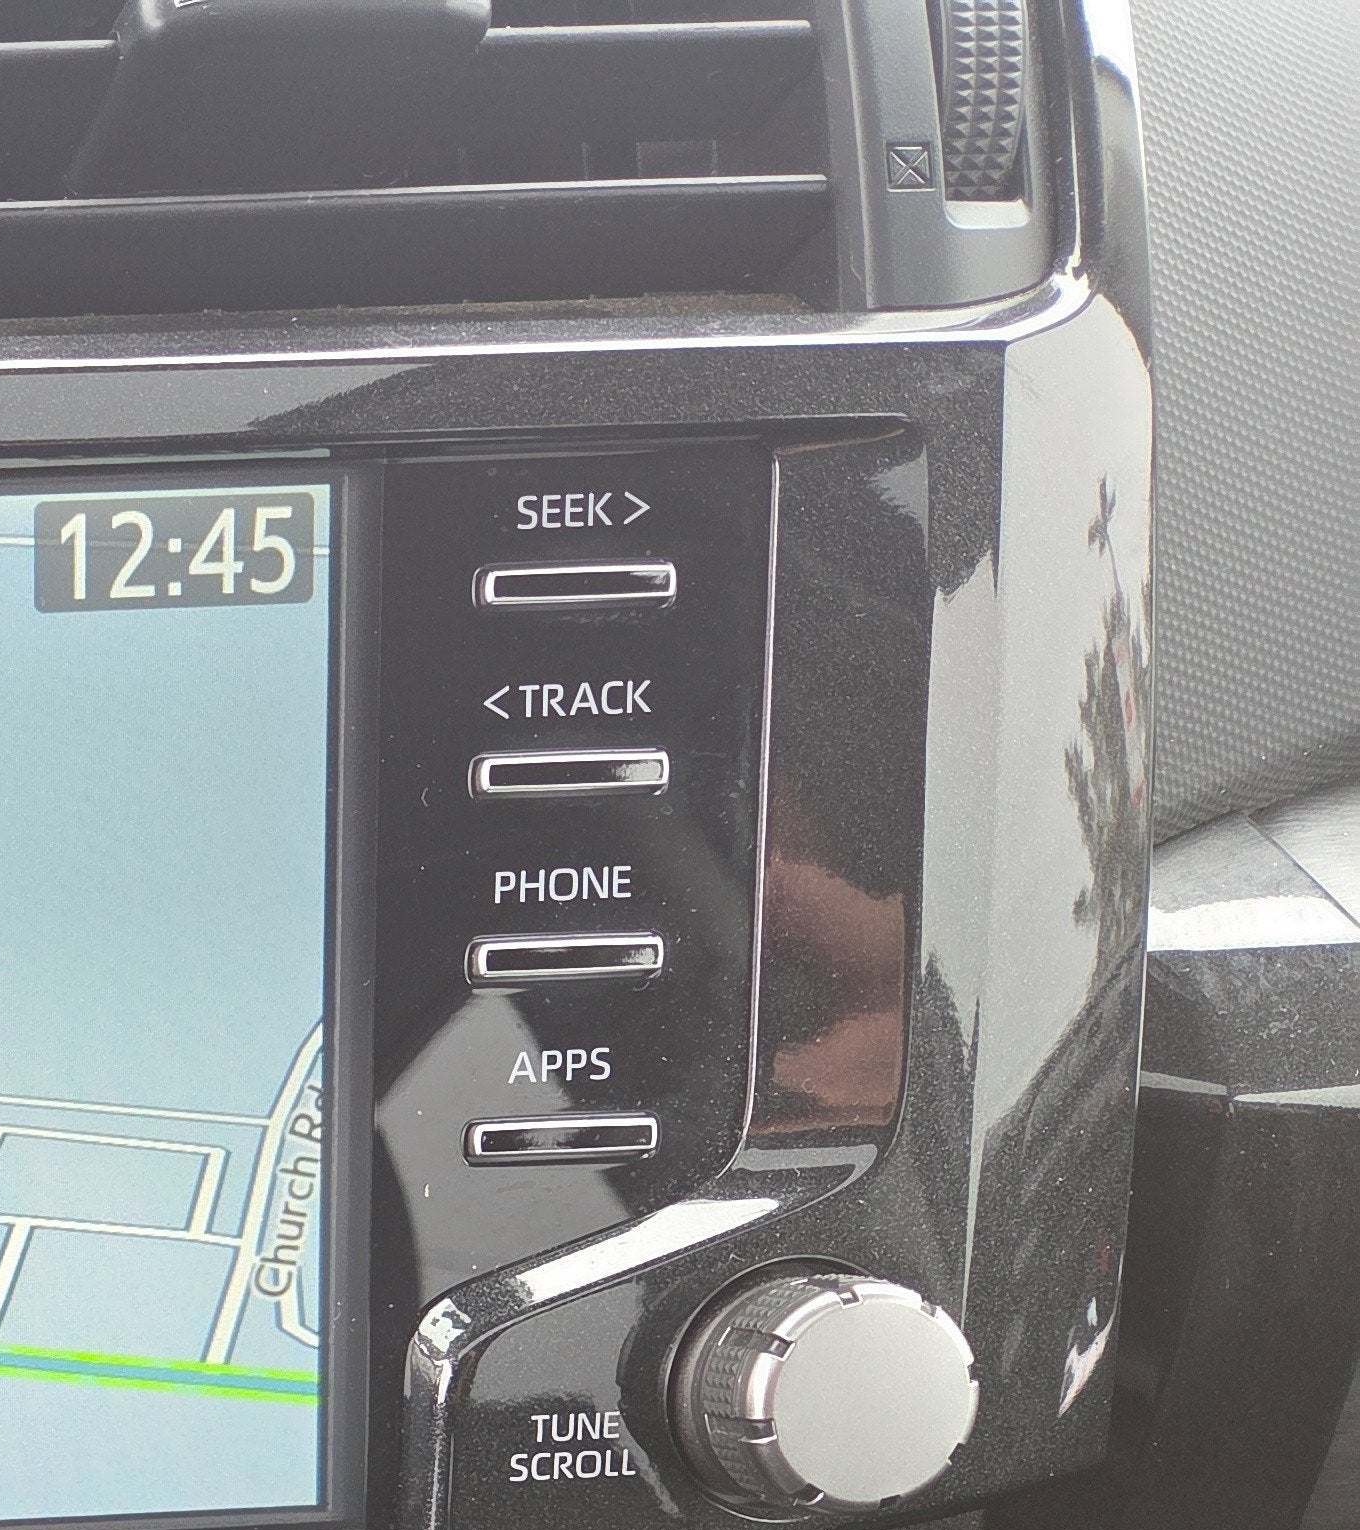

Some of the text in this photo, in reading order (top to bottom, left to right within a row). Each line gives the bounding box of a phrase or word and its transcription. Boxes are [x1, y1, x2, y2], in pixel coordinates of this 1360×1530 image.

[516, 493, 613, 530] SEEK
[59, 505, 297, 600] 12:45
[518, 679, 652, 718] TRACK
[494, 865, 632, 904] PHONE
[507, 1046, 611, 1084] APPS
[254, 1156, 319, 1299] Church
[530, 1410, 620, 1443] TUNE
[509, 1448, 637, 1482] SCROLL
